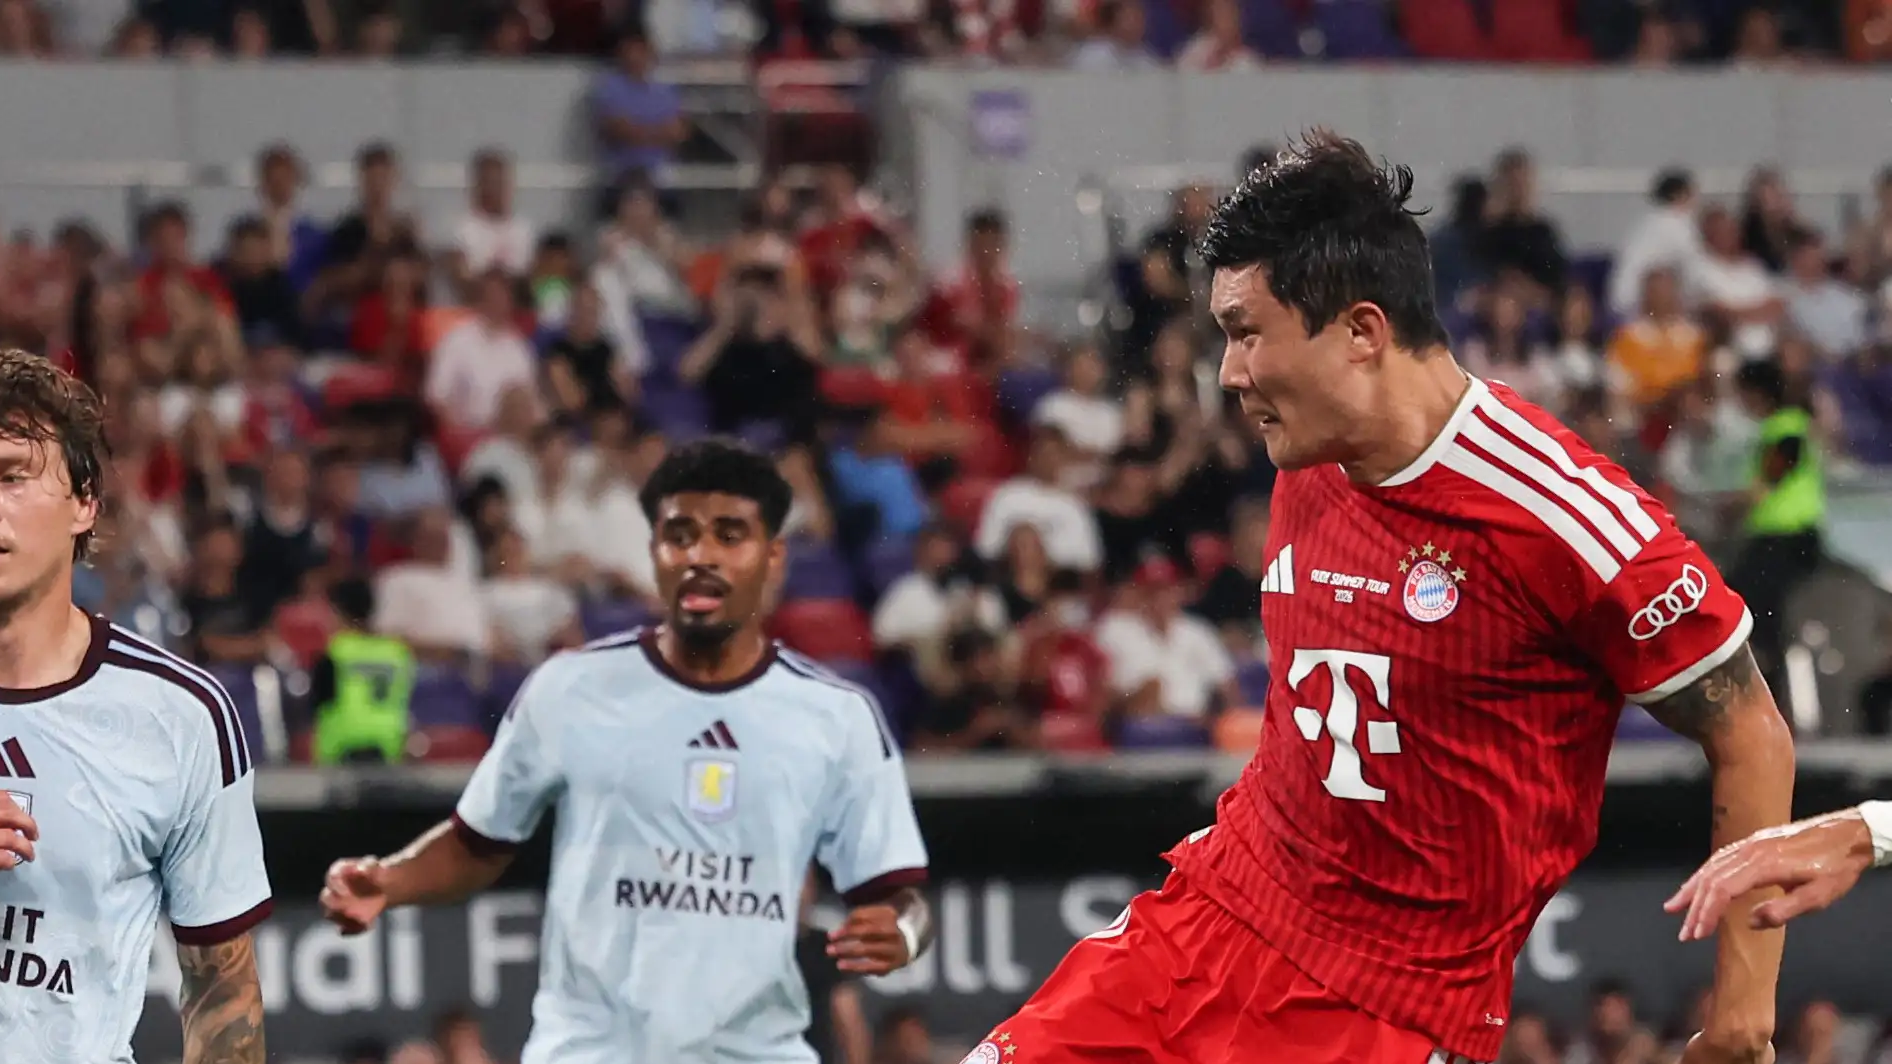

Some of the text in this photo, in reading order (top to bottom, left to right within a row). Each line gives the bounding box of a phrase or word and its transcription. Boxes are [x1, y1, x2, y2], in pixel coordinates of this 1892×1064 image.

[1330, 573, 1366, 589] SUMMER
[1365, 579, 1391, 595] TOUR
[656, 848, 754, 884] VISIT
[615, 878, 786, 922] RWANDA
